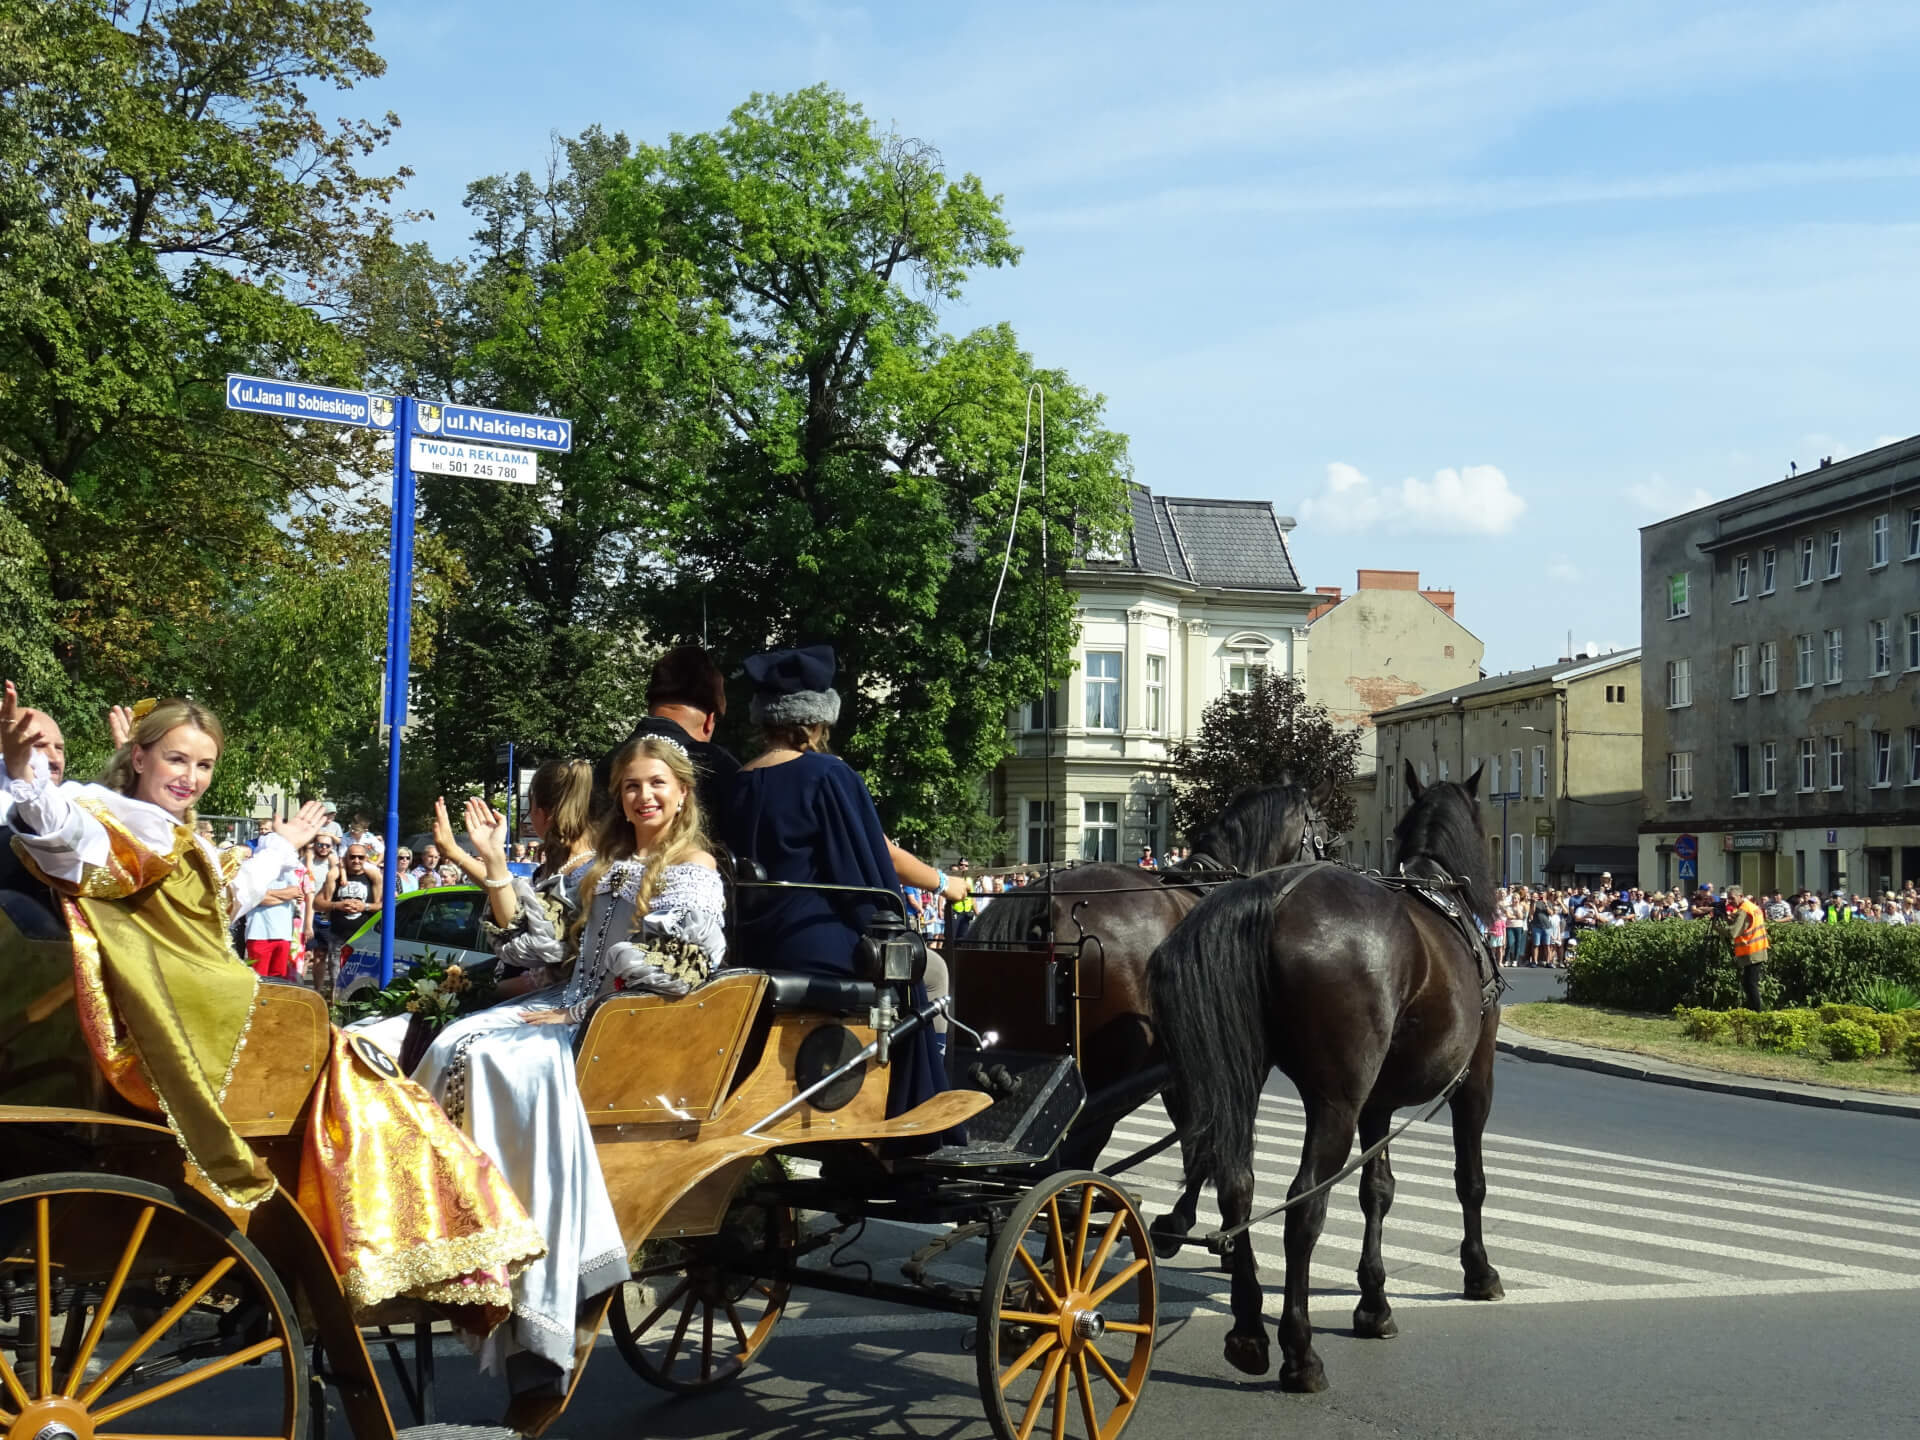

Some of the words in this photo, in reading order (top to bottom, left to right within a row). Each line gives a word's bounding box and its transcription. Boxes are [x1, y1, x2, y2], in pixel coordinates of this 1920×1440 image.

[241, 387, 282, 406] ul.Jana
[285, 392, 295, 408] III
[297, 394, 365, 419] Sobieskiego
[446, 415, 557, 442] ul.Nakielska
[419, 443, 464, 457] TWOJA
[468, 448, 530, 466] REKLAMA
[431, 461, 446, 471] tel.
[449, 460, 468, 473] 501
[473, 463, 494, 477] 245
[497, 466, 518, 479] 780
[361, 1042, 394, 1071] 16
